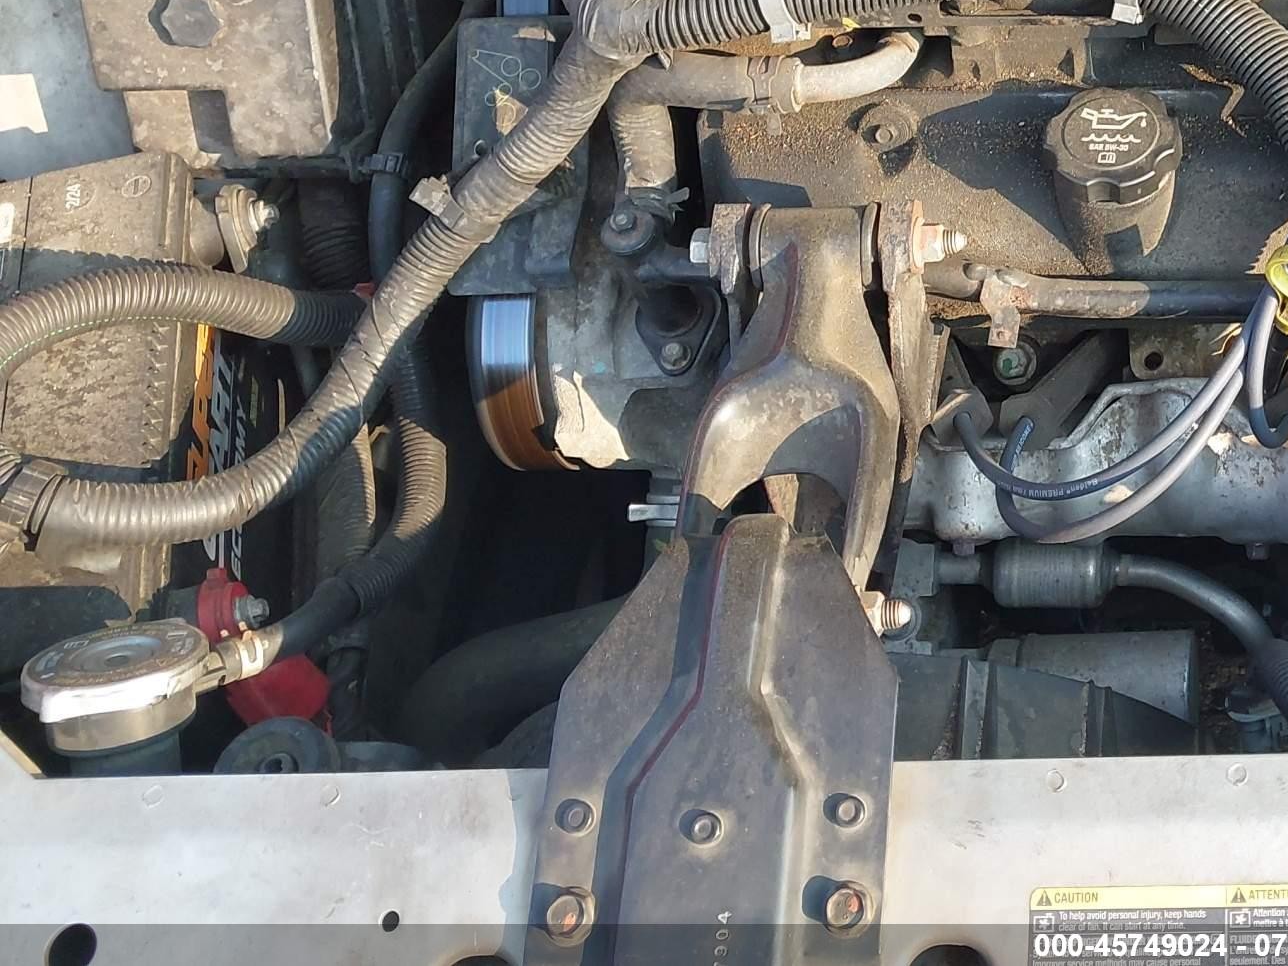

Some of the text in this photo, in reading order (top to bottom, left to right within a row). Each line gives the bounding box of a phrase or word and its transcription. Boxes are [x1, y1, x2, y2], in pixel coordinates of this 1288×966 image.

[1054, 892, 1099, 904] CAUTION
[1059, 909, 1206, 921] To help avoid personal injury, keep hands
[1252, 907, 1286, 918] Attention
[1059, 923, 1076, 932] clear
[1109, 923, 1124, 931] can
[1125, 922, 1141, 931] start
[1151, 922, 1167, 932] any
[1253, 918, 1276, 927] mettre
